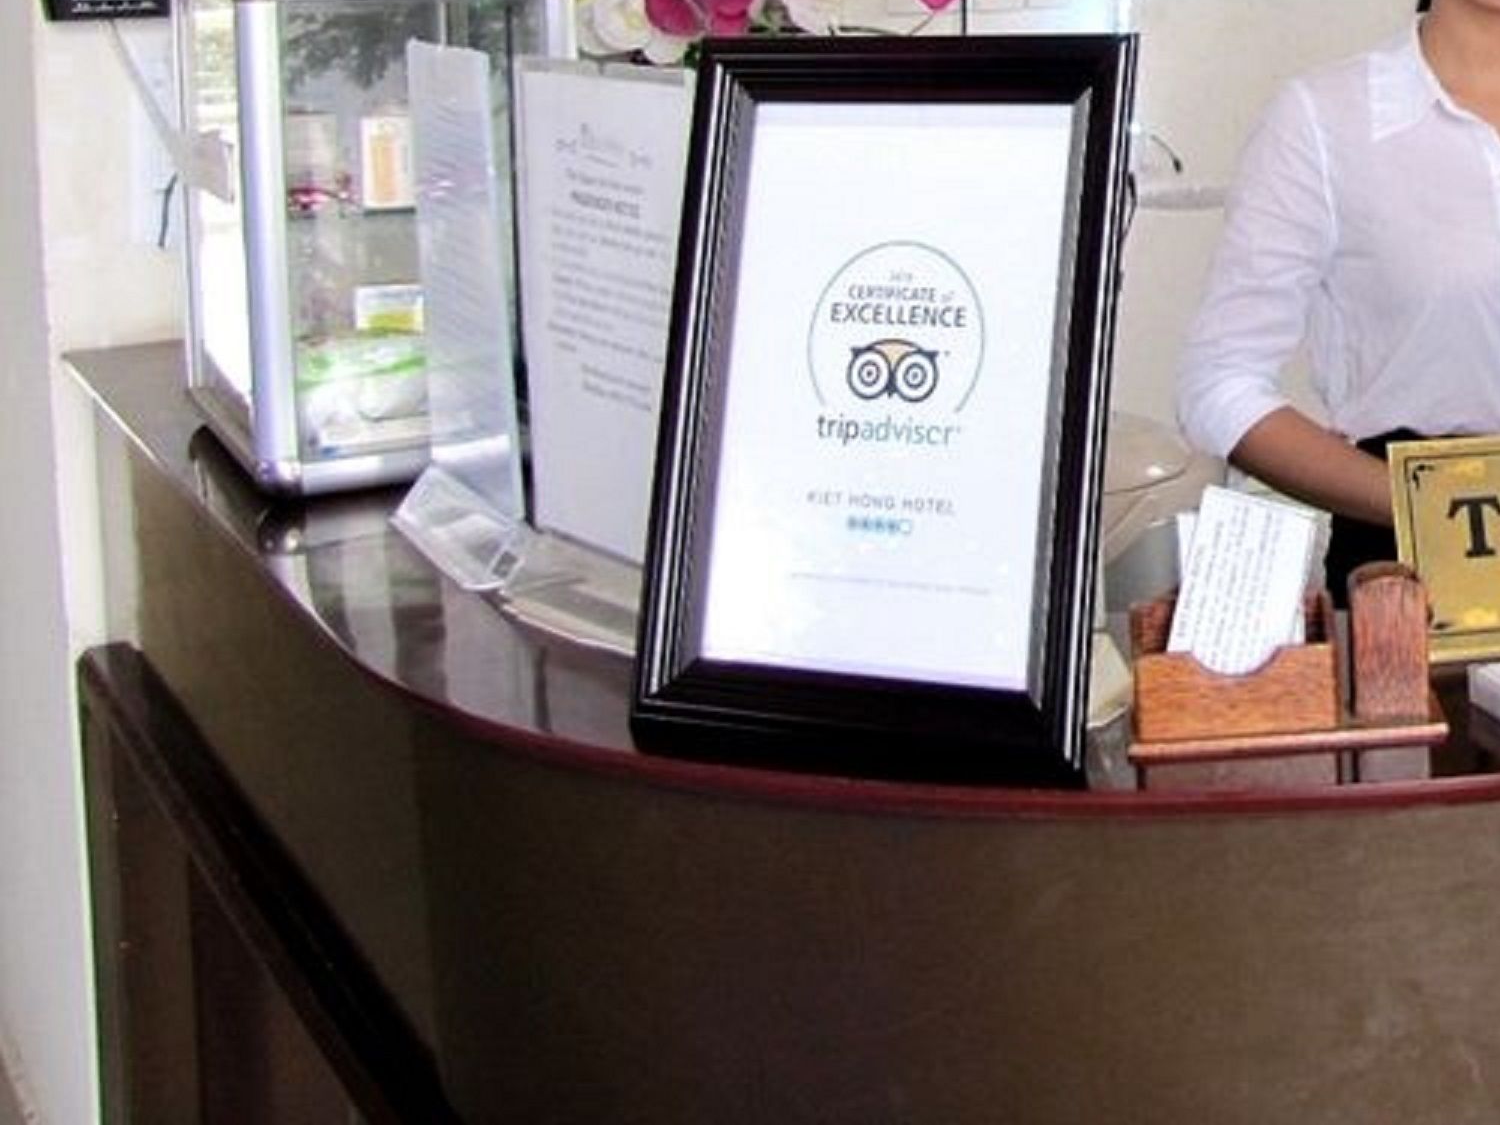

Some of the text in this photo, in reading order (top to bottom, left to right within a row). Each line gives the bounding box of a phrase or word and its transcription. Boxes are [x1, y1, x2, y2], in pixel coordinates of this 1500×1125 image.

[848, 284, 936, 302] CERTIFICATE
[830, 302, 967, 328] EXCELLENCE
[902, 498, 955, 515] HOTEL
